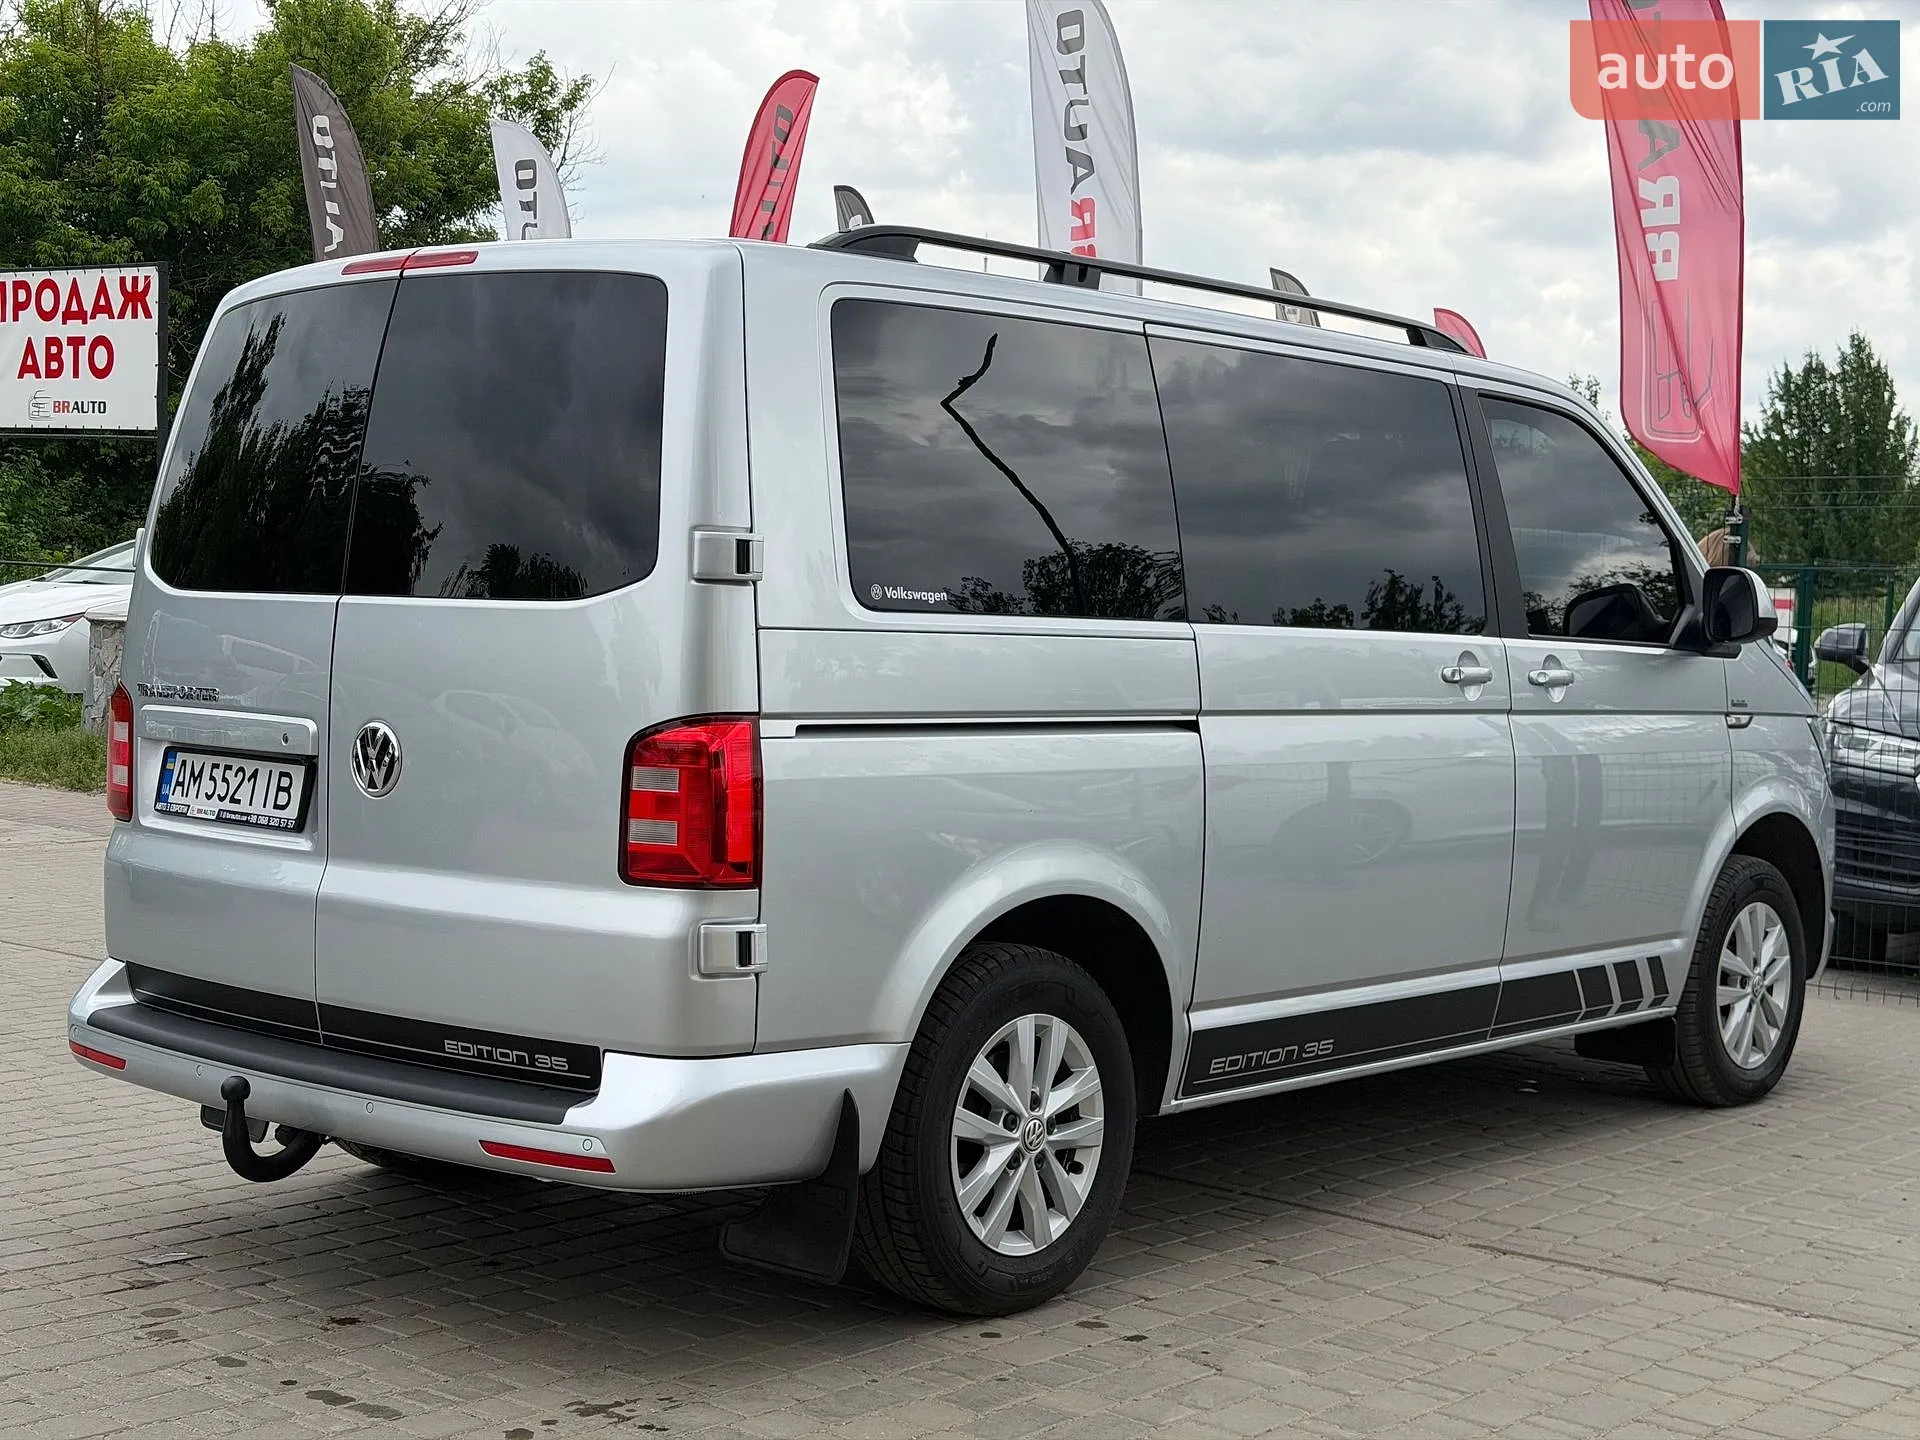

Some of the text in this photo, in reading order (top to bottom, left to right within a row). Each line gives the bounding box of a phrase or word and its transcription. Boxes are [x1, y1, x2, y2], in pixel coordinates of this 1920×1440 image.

[17, 335, 115, 379] АВТО
[53, 400, 107, 414] BRAUTO
[884, 586, 948, 604] Volkswagen
[444, 1039, 569, 1071] EDITION 35
[1208, 1039, 1335, 1075] EDITION 35
